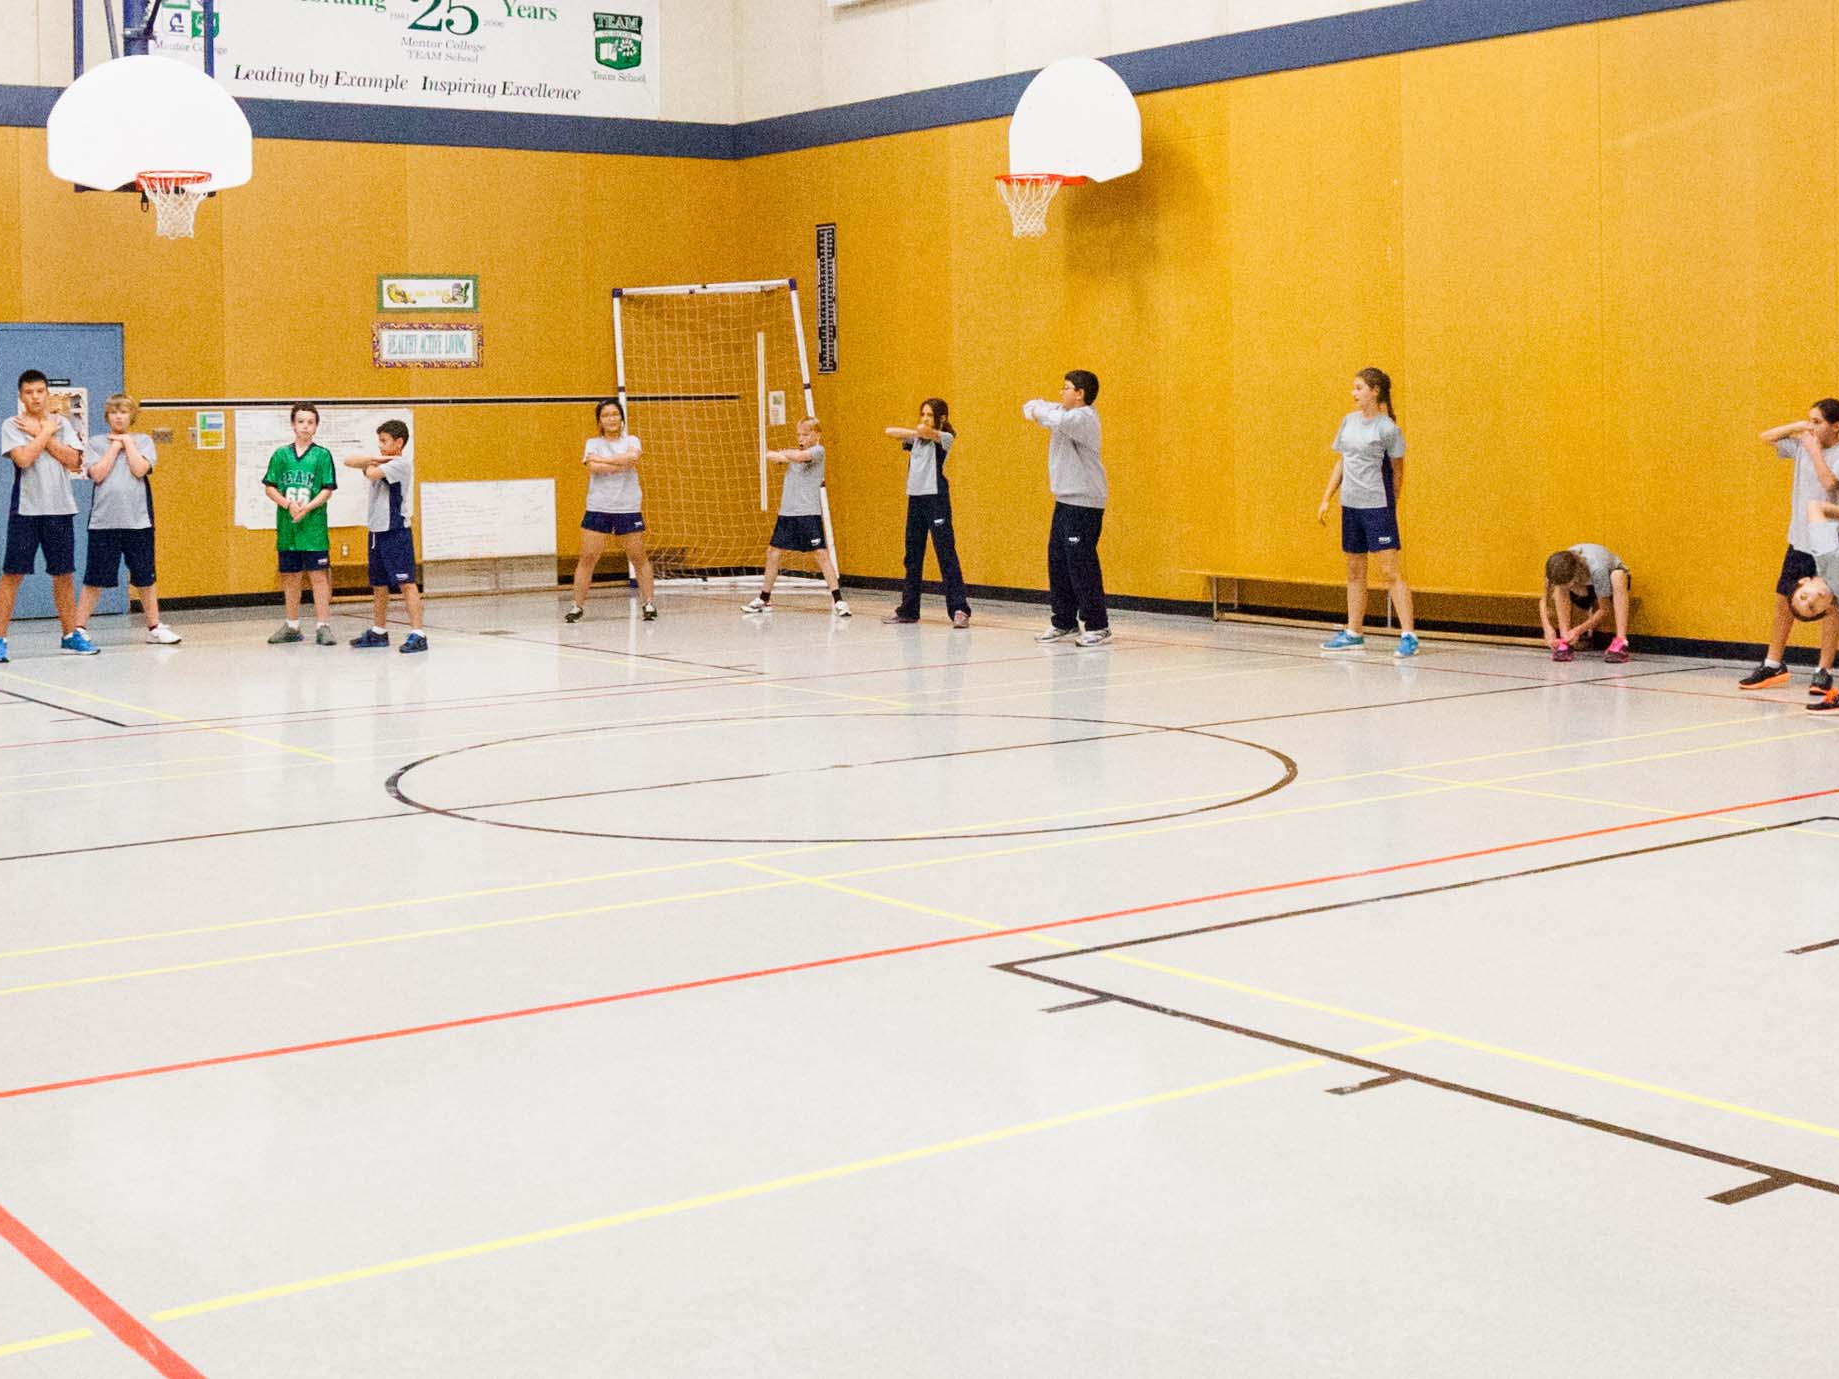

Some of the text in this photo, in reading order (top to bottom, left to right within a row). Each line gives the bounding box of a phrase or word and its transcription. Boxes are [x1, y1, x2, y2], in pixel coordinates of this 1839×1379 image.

[407, 0, 479, 36] 25
[503, 0, 558, 21] Years
[595, 14, 640, 31] TEAM
[401, 36, 486, 52] Mentor College
[407, 49, 479, 63] TEAM School
[234, 64, 582, 101] Leading by Example Inspiring Excellence
[592, 70, 647, 84] Team School
[386, 333, 467, 355] HEALTHY ACTIVE LIVING
[278, 469, 315, 489] EAM
